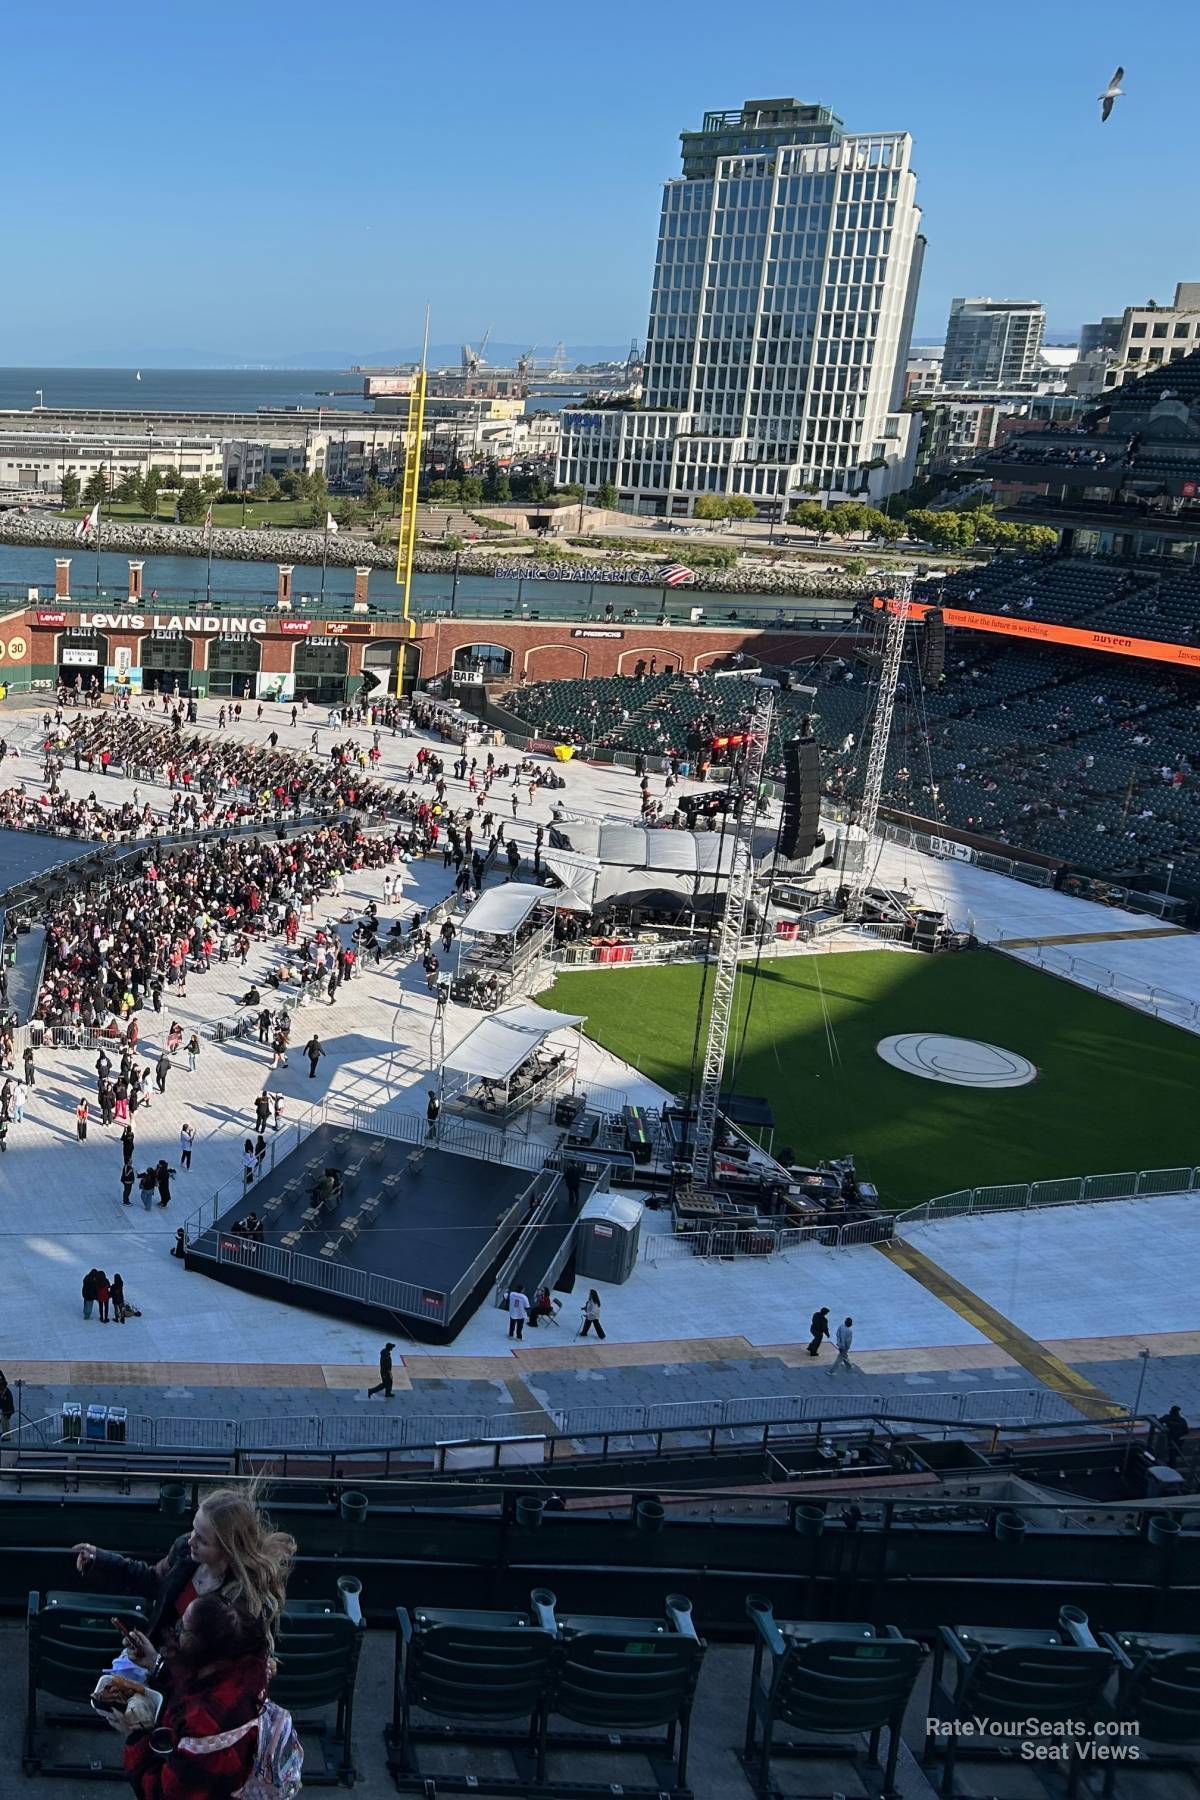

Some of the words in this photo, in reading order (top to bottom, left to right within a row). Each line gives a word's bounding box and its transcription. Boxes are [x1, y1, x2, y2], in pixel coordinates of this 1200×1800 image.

[495, 567, 543, 579] BANK
[547, 568, 570, 581] OF
[572, 569, 652, 582] AMERICA
[153, 615, 267, 633] LANDING
[948, 613, 967, 623] Invest
[968, 615, 979, 624] like
[980, 617, 990, 625] the
[991, 618, 1011, 630] future
[72, 627, 92, 636] EXIT
[156, 630, 177, 639] EXIT
[224, 632, 246, 642] EXIT
[311, 637, 334, 646] EXIT
[1092, 634, 1132, 648] nuveen
[11, 643, 23, 654] 30
[453, 670, 475, 682] BAR
